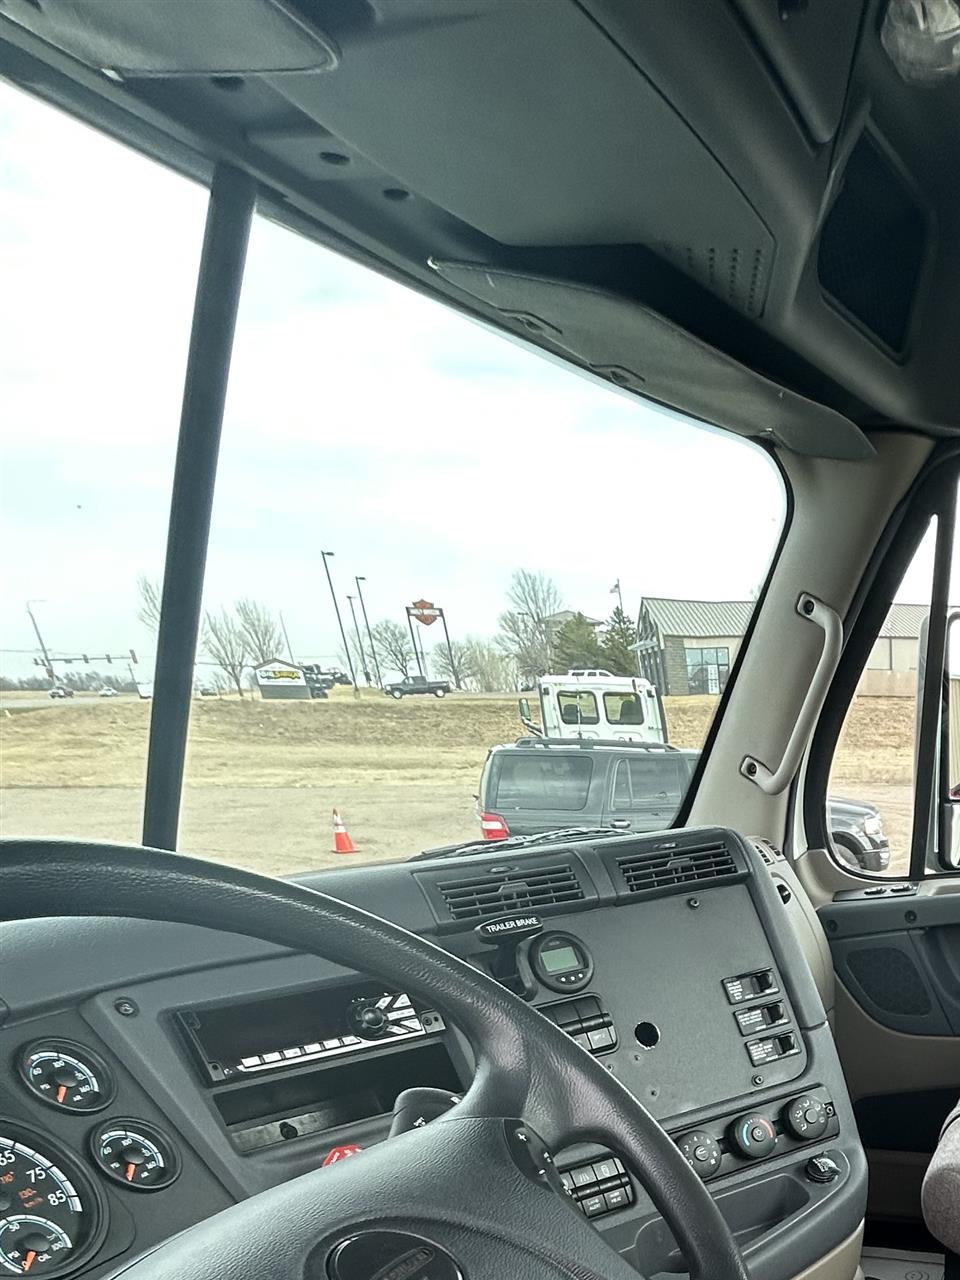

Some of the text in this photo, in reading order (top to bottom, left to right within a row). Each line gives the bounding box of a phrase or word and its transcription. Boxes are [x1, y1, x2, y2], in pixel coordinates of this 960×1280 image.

[486, 917, 539, 933] TRAILER BRAKE
[25, 1166, 46, 1183] 75
[47, 1189, 67, 1206] 85
